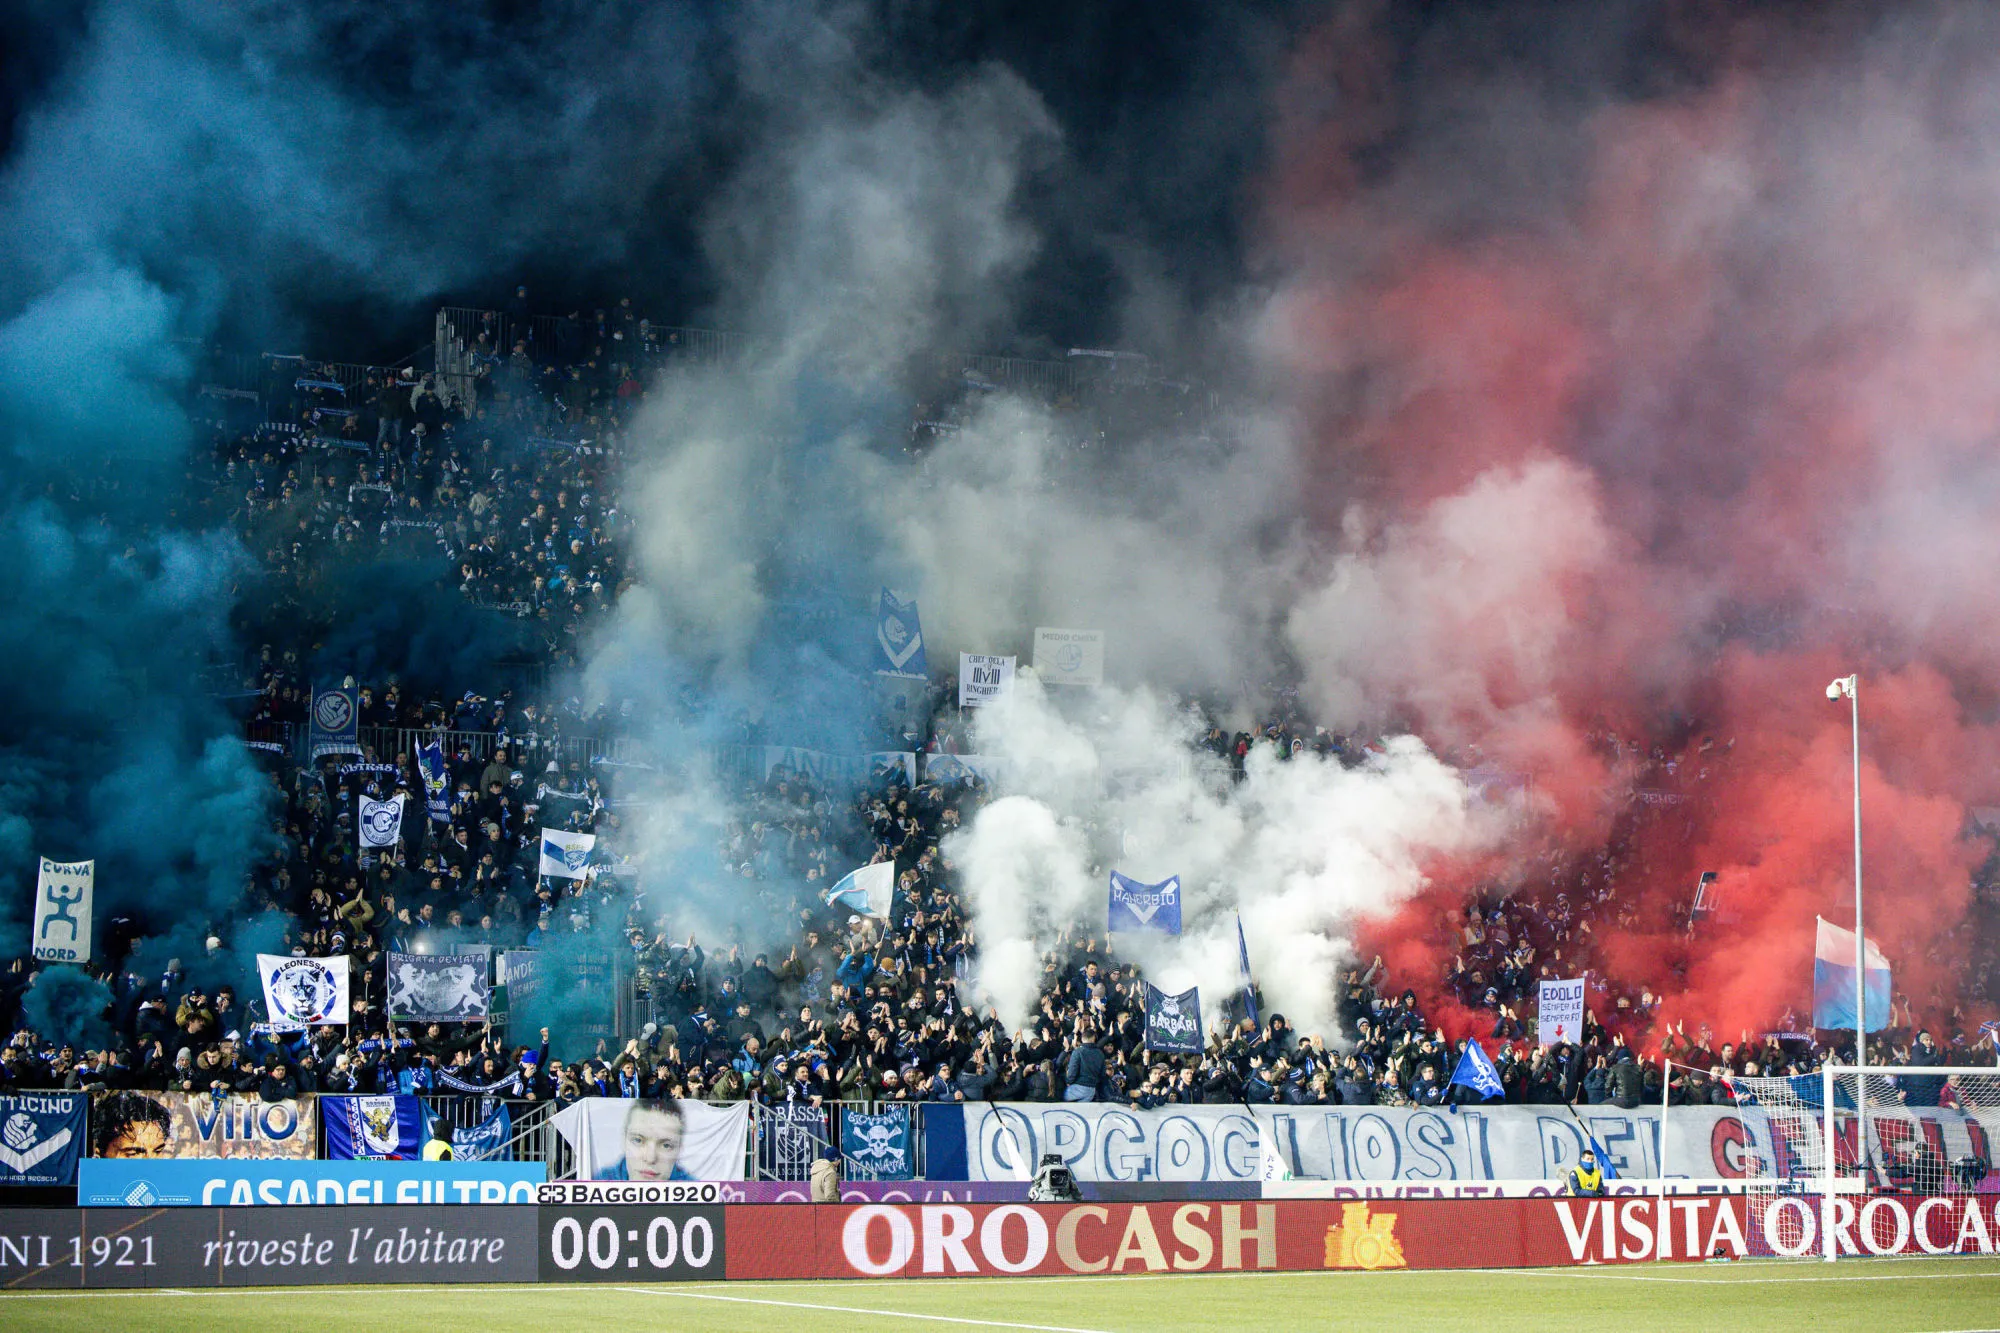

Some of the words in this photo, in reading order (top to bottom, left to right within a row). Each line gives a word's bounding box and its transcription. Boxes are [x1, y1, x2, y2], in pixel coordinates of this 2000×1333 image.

[369, 803, 396, 813] RONCO
[42, 861, 91, 877] CURVA
[1113, 890, 1175, 906] MANERBIO
[34, 946, 77, 961] NORD
[391, 953, 435, 963] BRIGATA
[279, 959, 325, 973] LEONESSA
[1543, 985, 1581, 1001] EDOLO
[1149, 1014, 1198, 1031] BARBARI
[1553, 1199, 1748, 1261] VISITA
[69, 1236, 158, 1266] 1921
[203, 1234, 334, 1267] riveste
[348, 1228, 504, 1264] l'abitare
[551, 1217, 713, 1270] 00:00
[841, 1203, 1277, 1276] OROCASH
